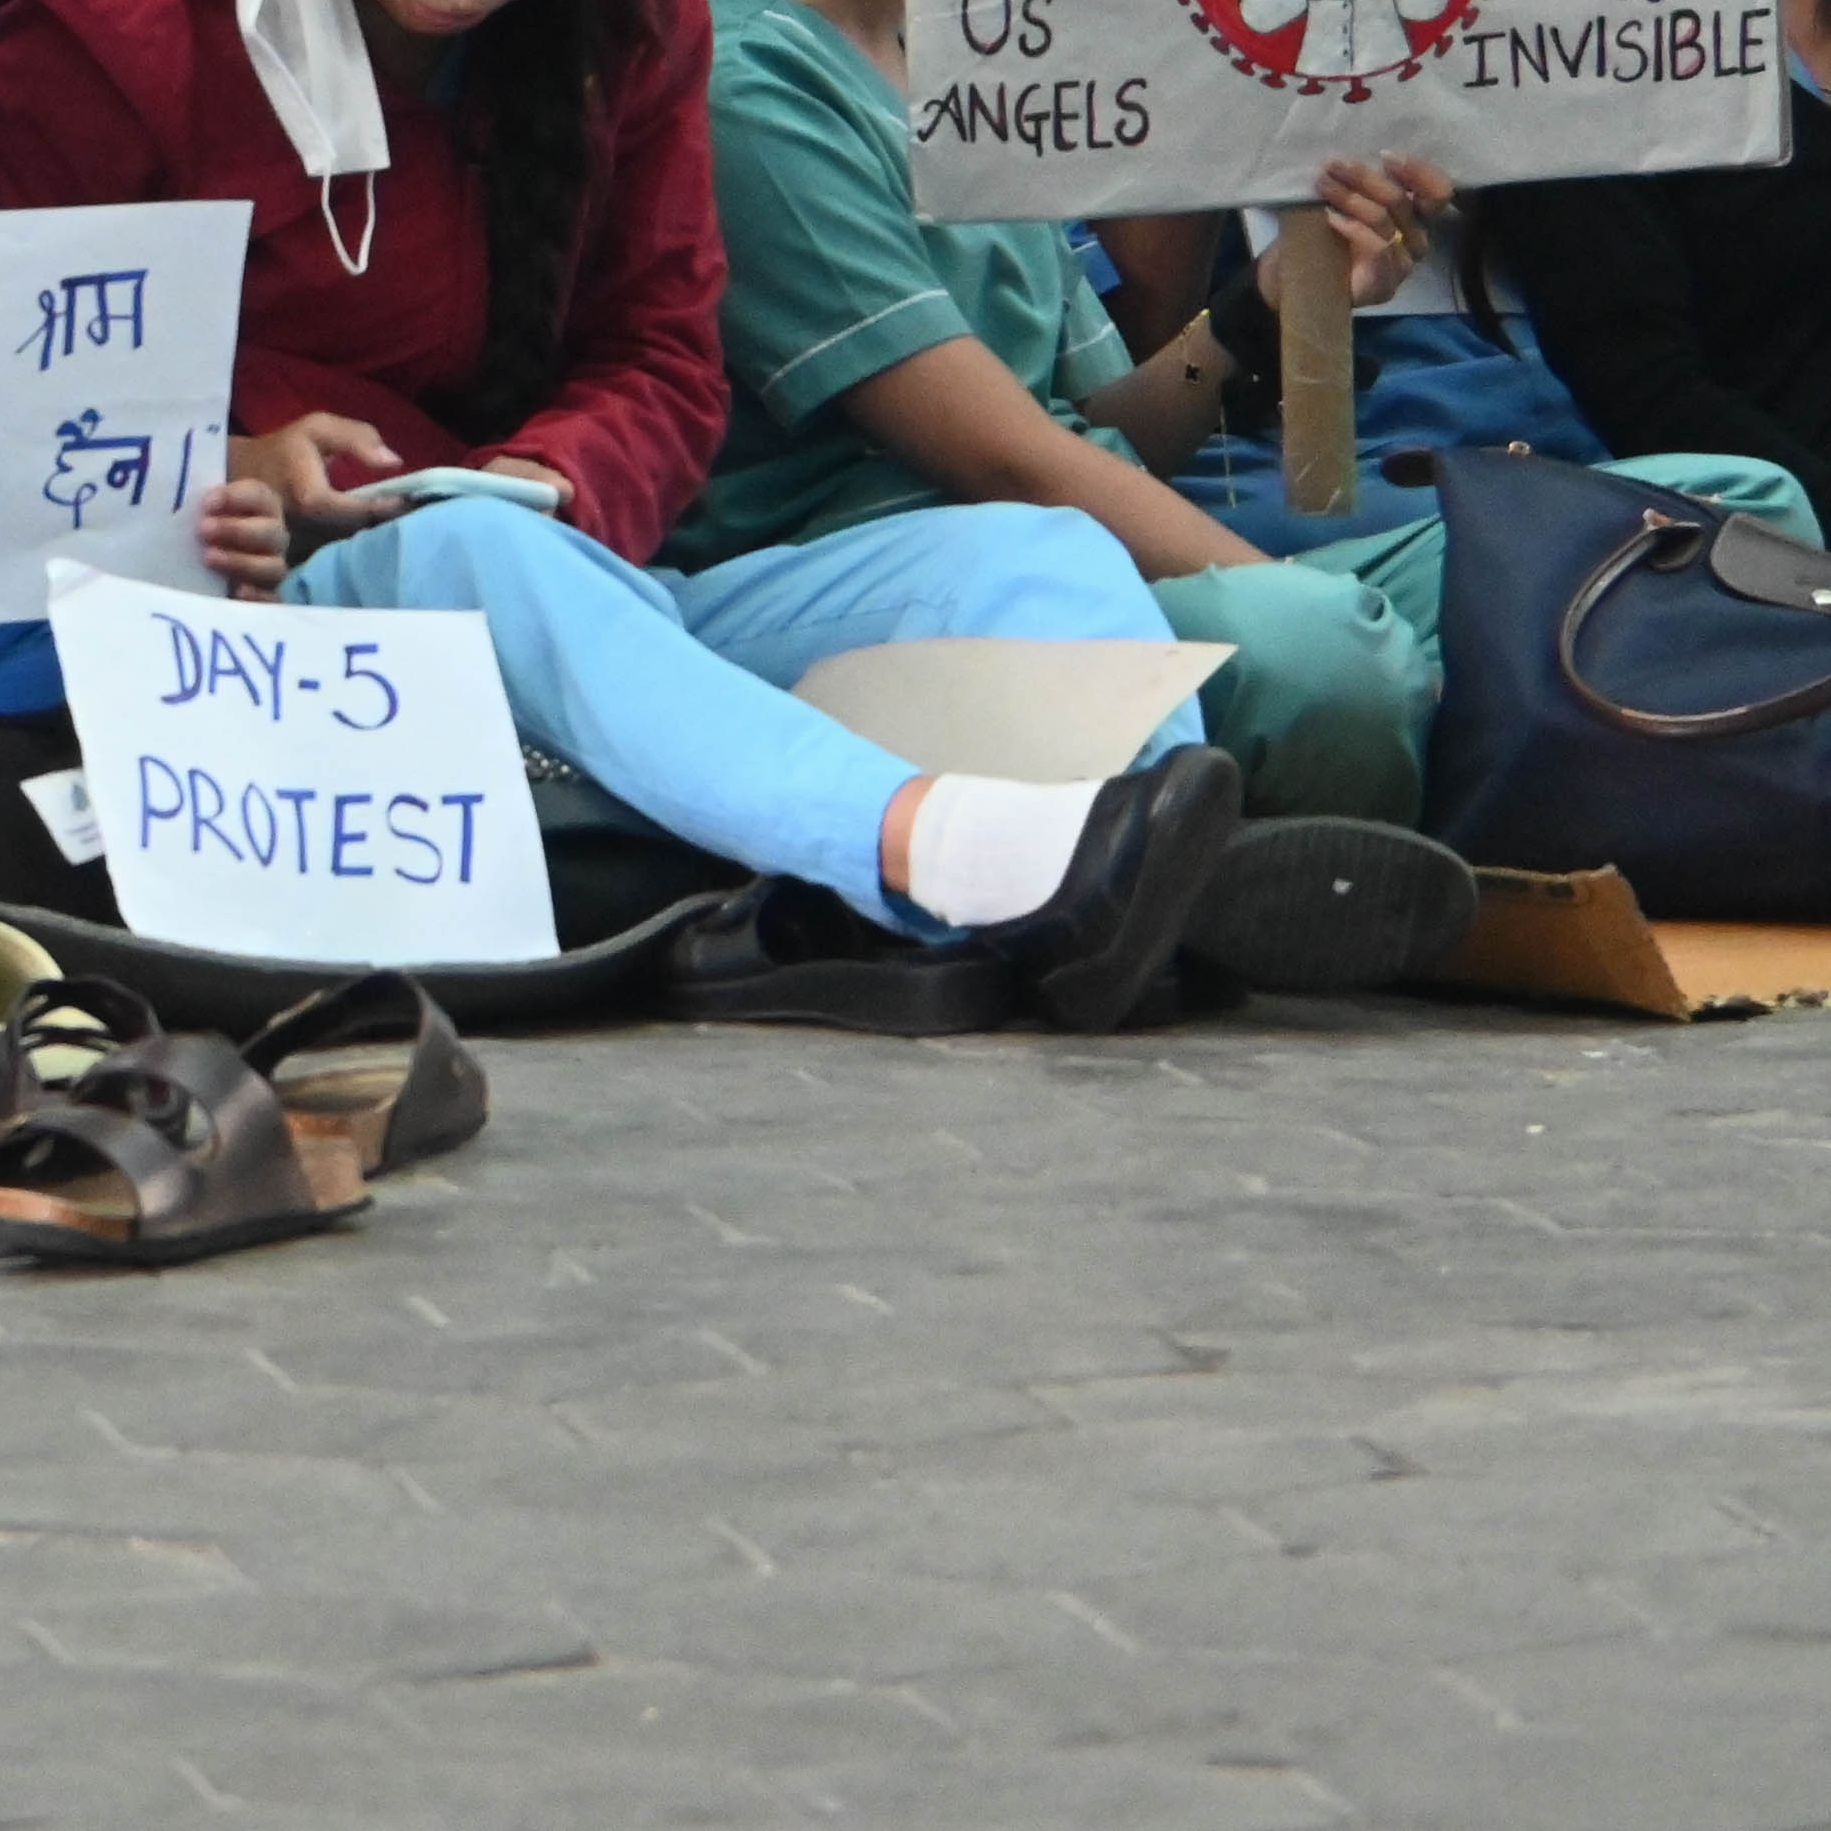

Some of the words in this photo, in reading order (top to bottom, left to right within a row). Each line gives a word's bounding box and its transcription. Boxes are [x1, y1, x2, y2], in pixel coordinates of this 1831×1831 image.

[1462, 7, 1773, 90] INVISIBLE
[917, 78, 1153, 159] ANGELS
[14, 267, 150, 372] श्रम
[151, 611, 399, 731] DAY-5
[138, 754, 486, 886] PROTEST
